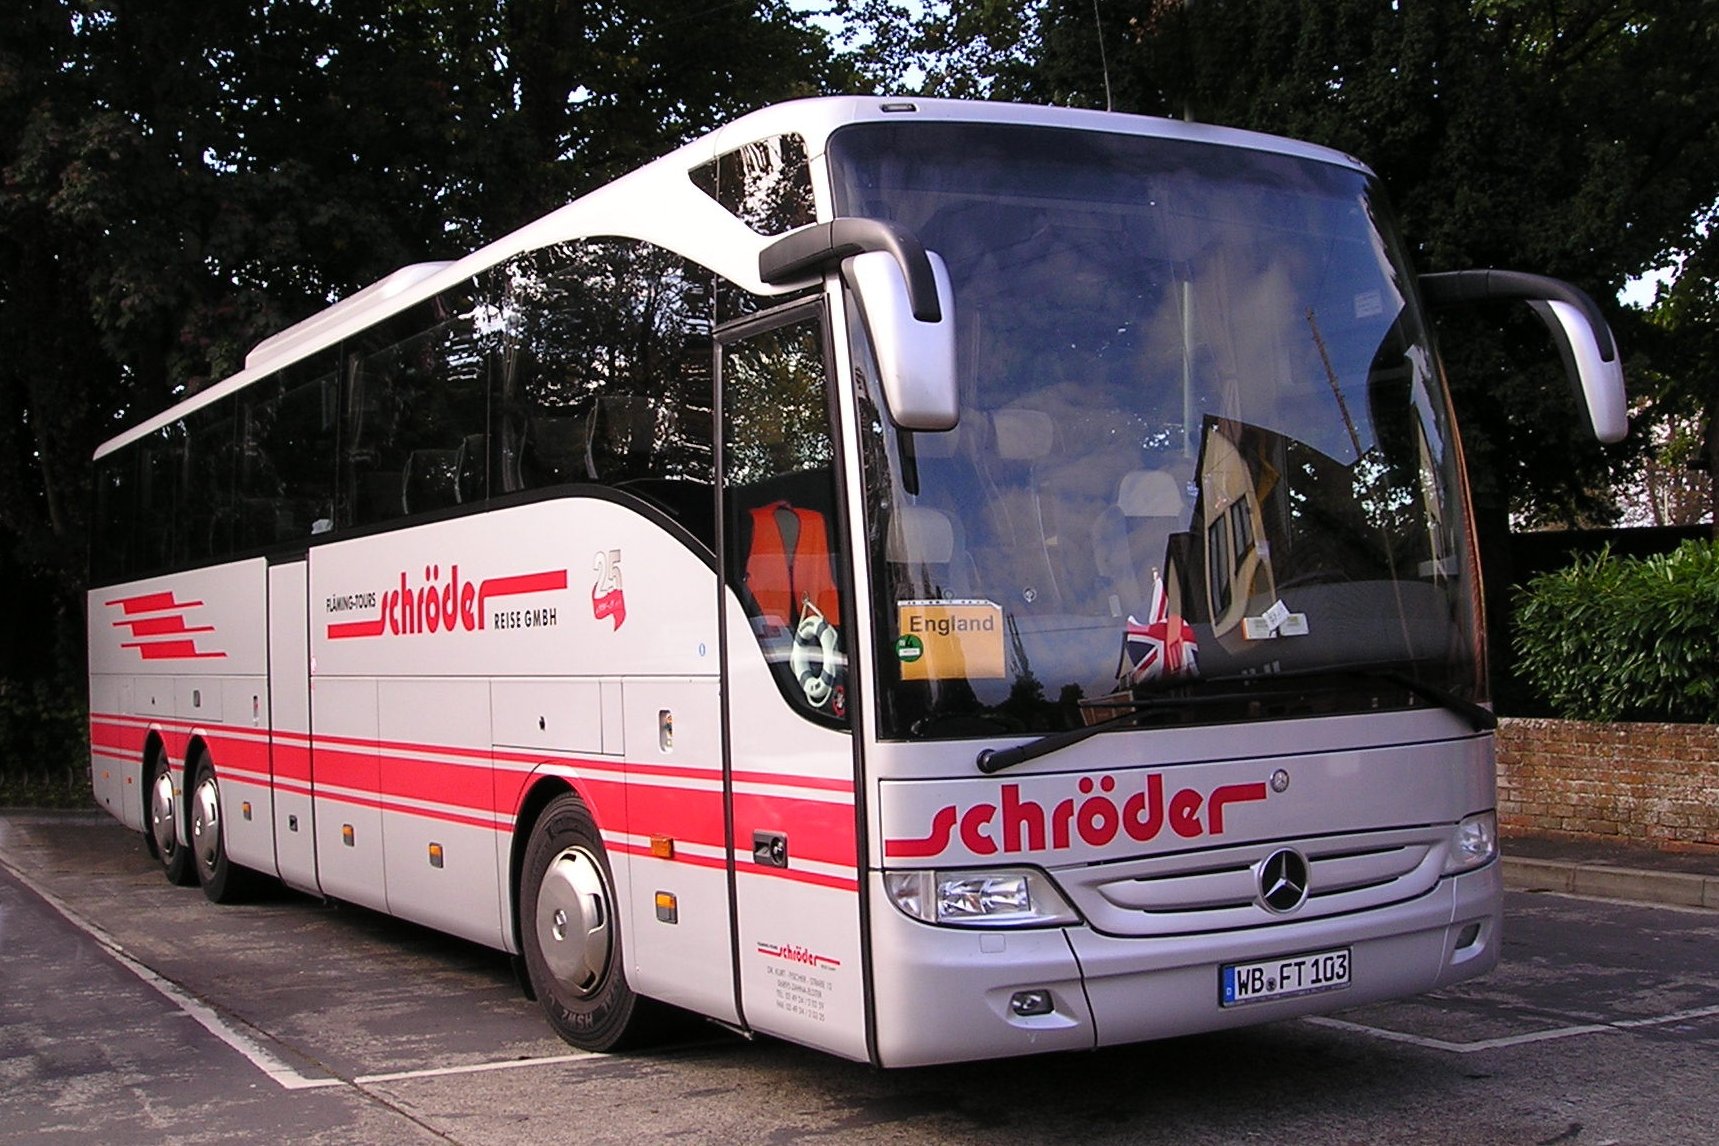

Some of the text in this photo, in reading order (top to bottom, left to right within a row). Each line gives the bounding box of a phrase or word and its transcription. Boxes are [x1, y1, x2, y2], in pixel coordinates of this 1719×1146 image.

[592, 549, 622, 594] 25
[494, 608, 557, 629] REISE GMBH
[910, 615, 994, 635] England
[885, 773, 1266, 857] schröder
[1237, 967, 1265, 996] WB
[1280, 961, 1306, 989] FT
[1311, 954, 1347, 985] 103
